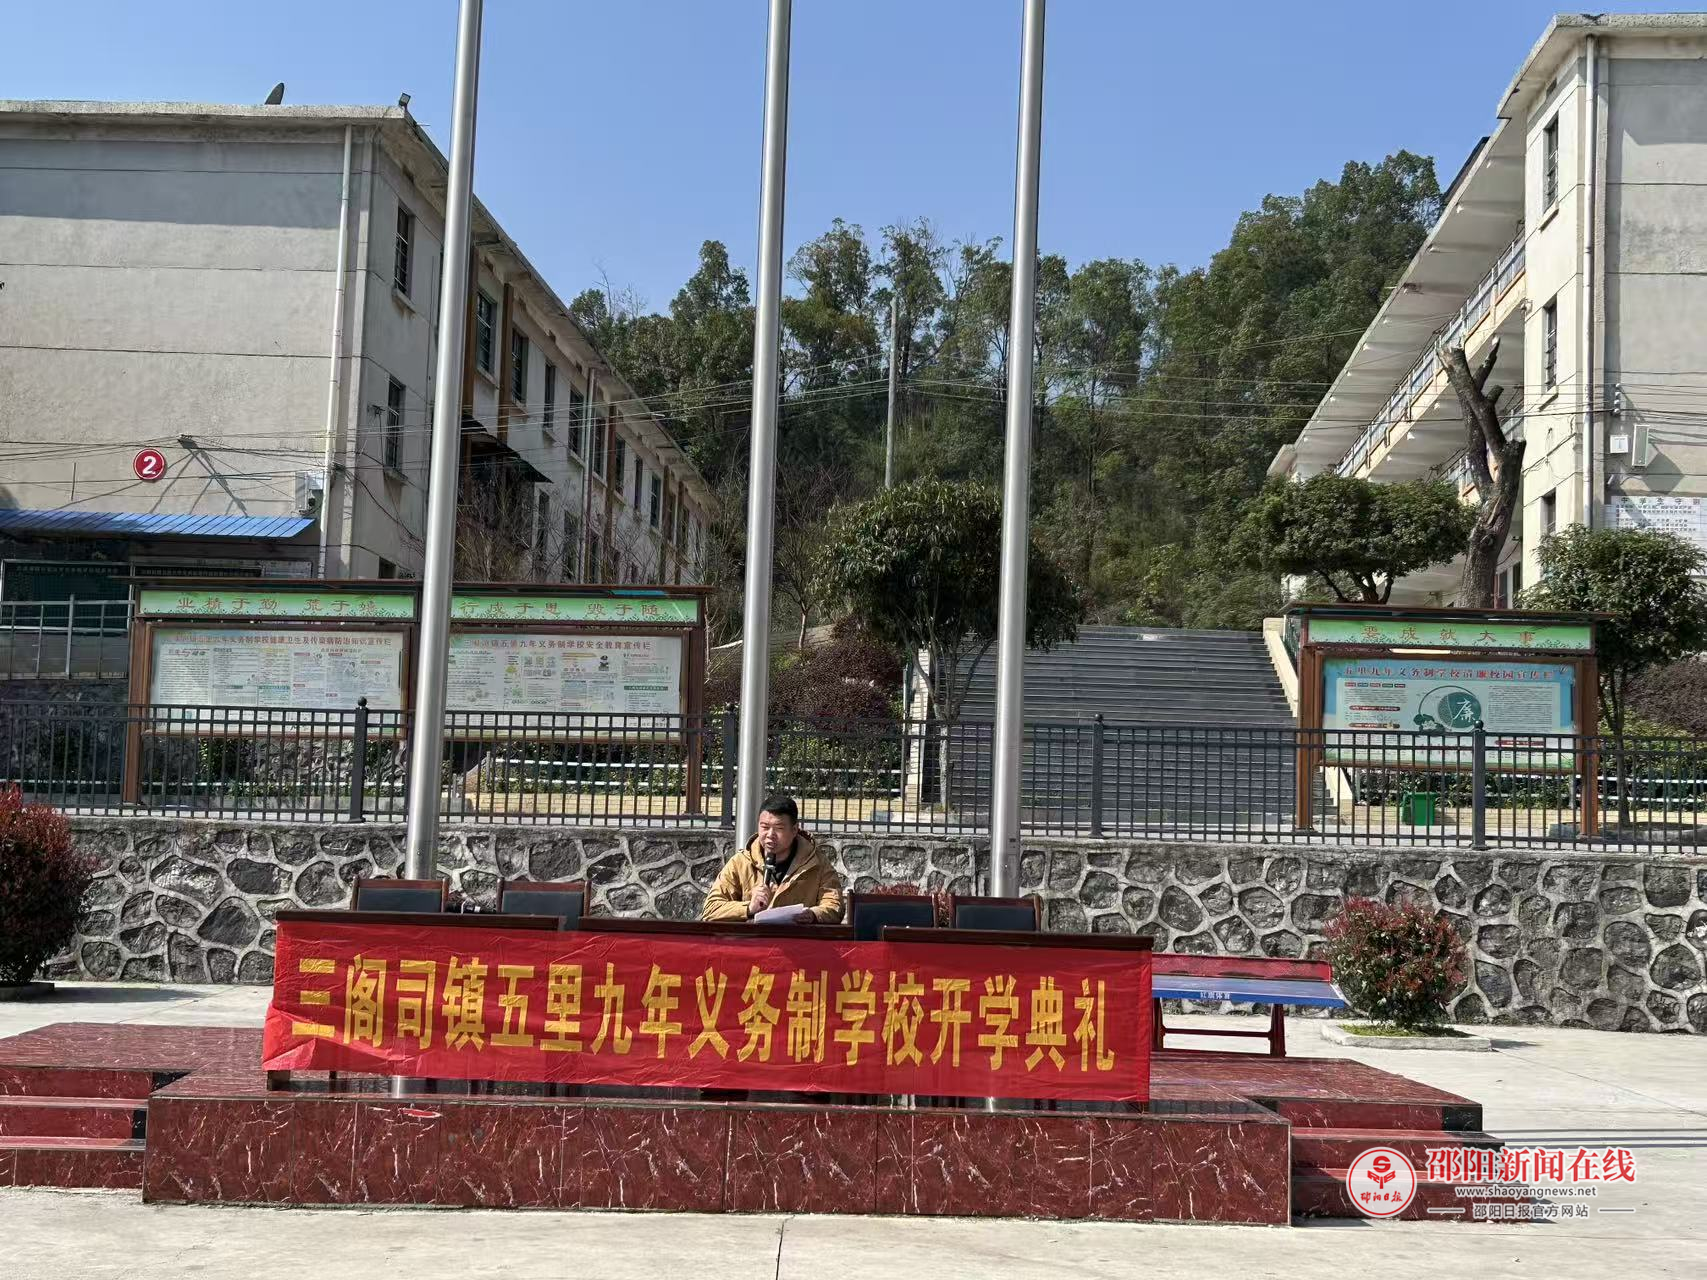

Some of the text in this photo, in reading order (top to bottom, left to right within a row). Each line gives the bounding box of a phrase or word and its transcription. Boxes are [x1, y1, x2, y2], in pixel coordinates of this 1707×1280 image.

[142, 455, 156, 475] 2
[1361, 625, 1536, 645] 要成就大事
[291, 954, 1115, 1072] 三阁司镇五里九年义务制学校开学典礼
